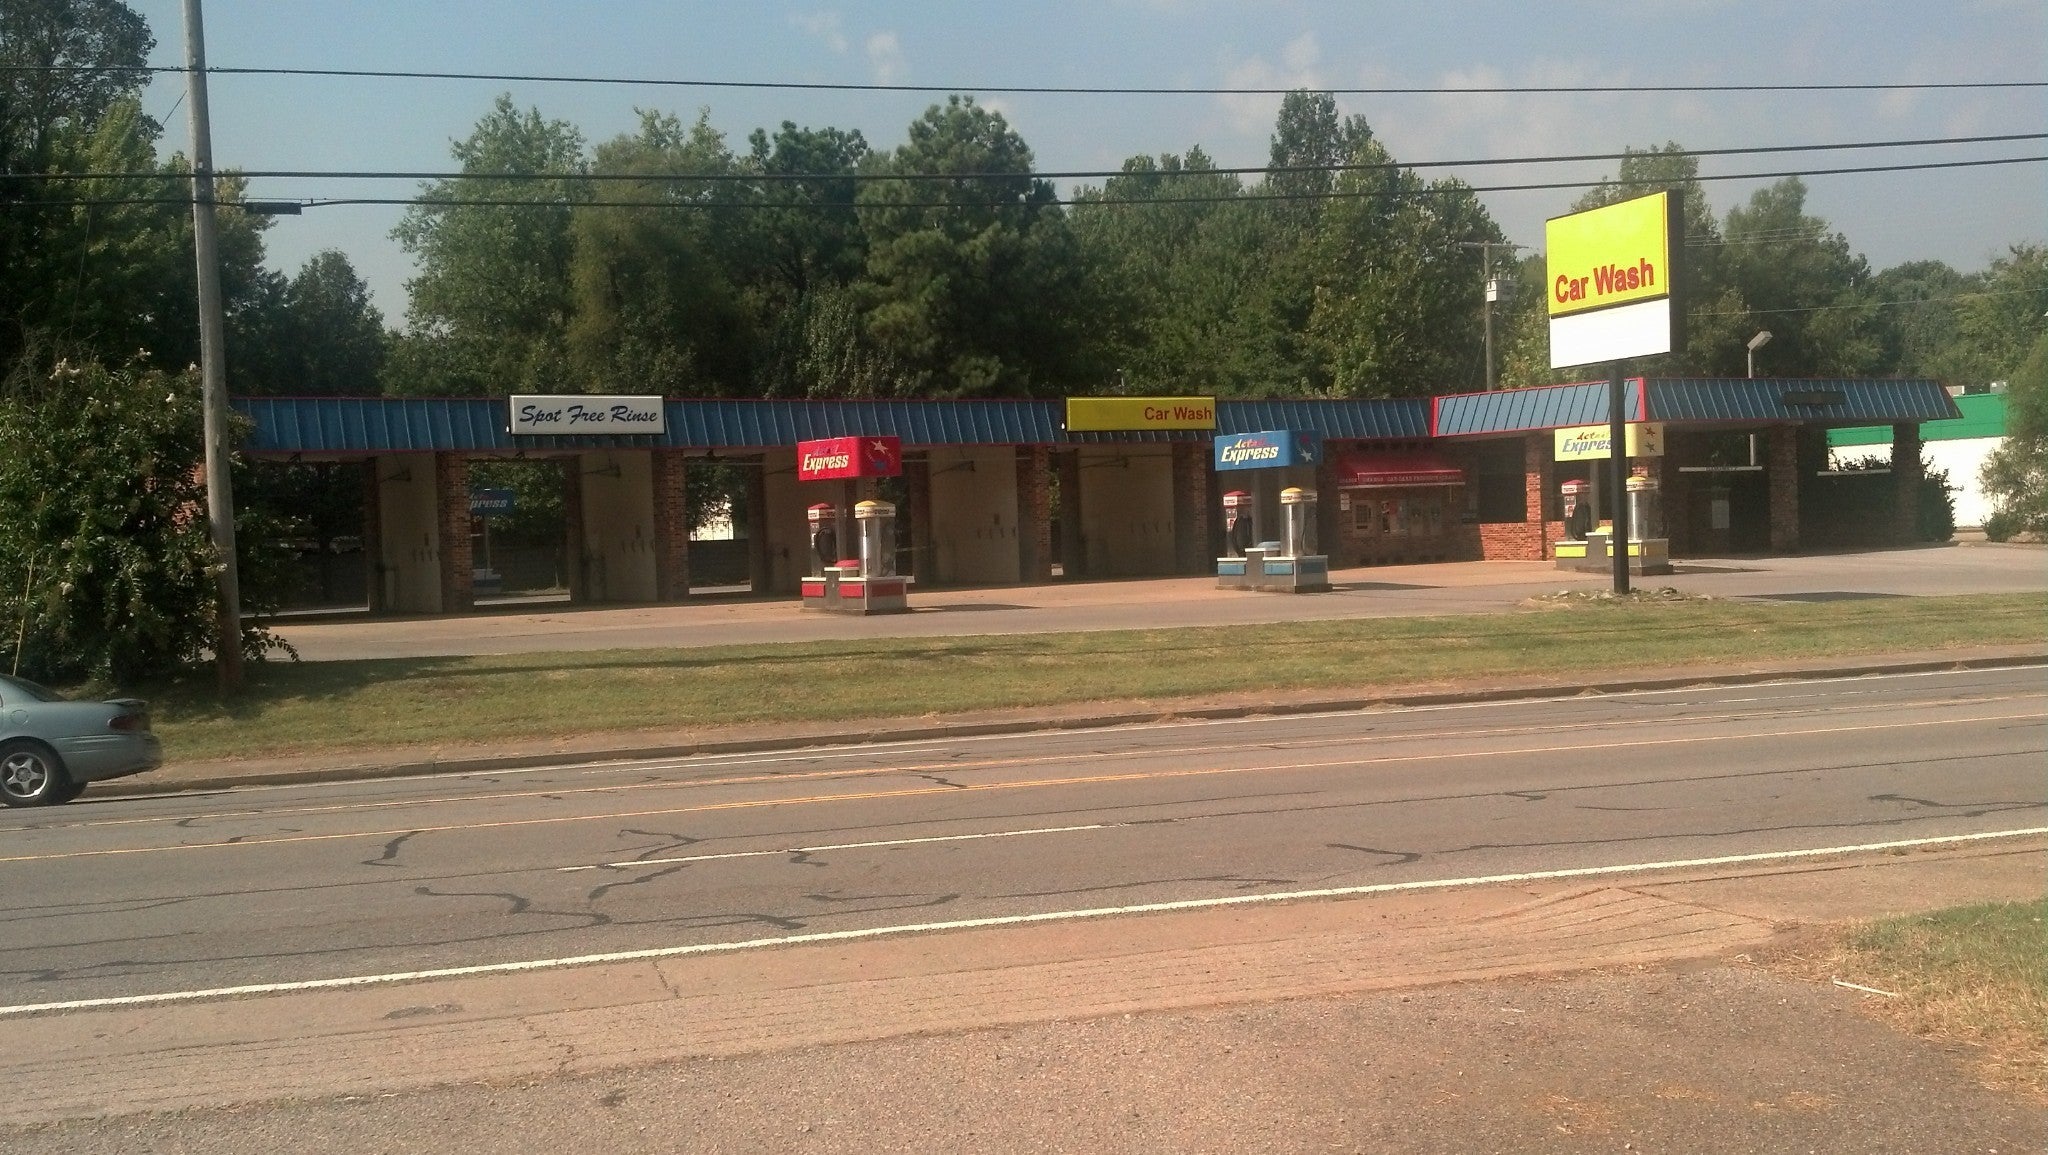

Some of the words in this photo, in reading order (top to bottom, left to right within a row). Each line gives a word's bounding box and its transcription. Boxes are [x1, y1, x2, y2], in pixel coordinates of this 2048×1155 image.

[1555, 274, 1589, 303] Car
[1593, 257, 1654, 295] Wash
[519, 405, 561, 426] Spot
[567, 405, 605, 424] Free
[610, 405, 657, 422] Rinse
[1144, 407, 1169, 420] Car
[1174, 407, 1212, 420] Wash
[1221, 446, 1279, 465] Express
[1562, 438, 1611, 455] Expres
[803, 454, 849, 475] Express
